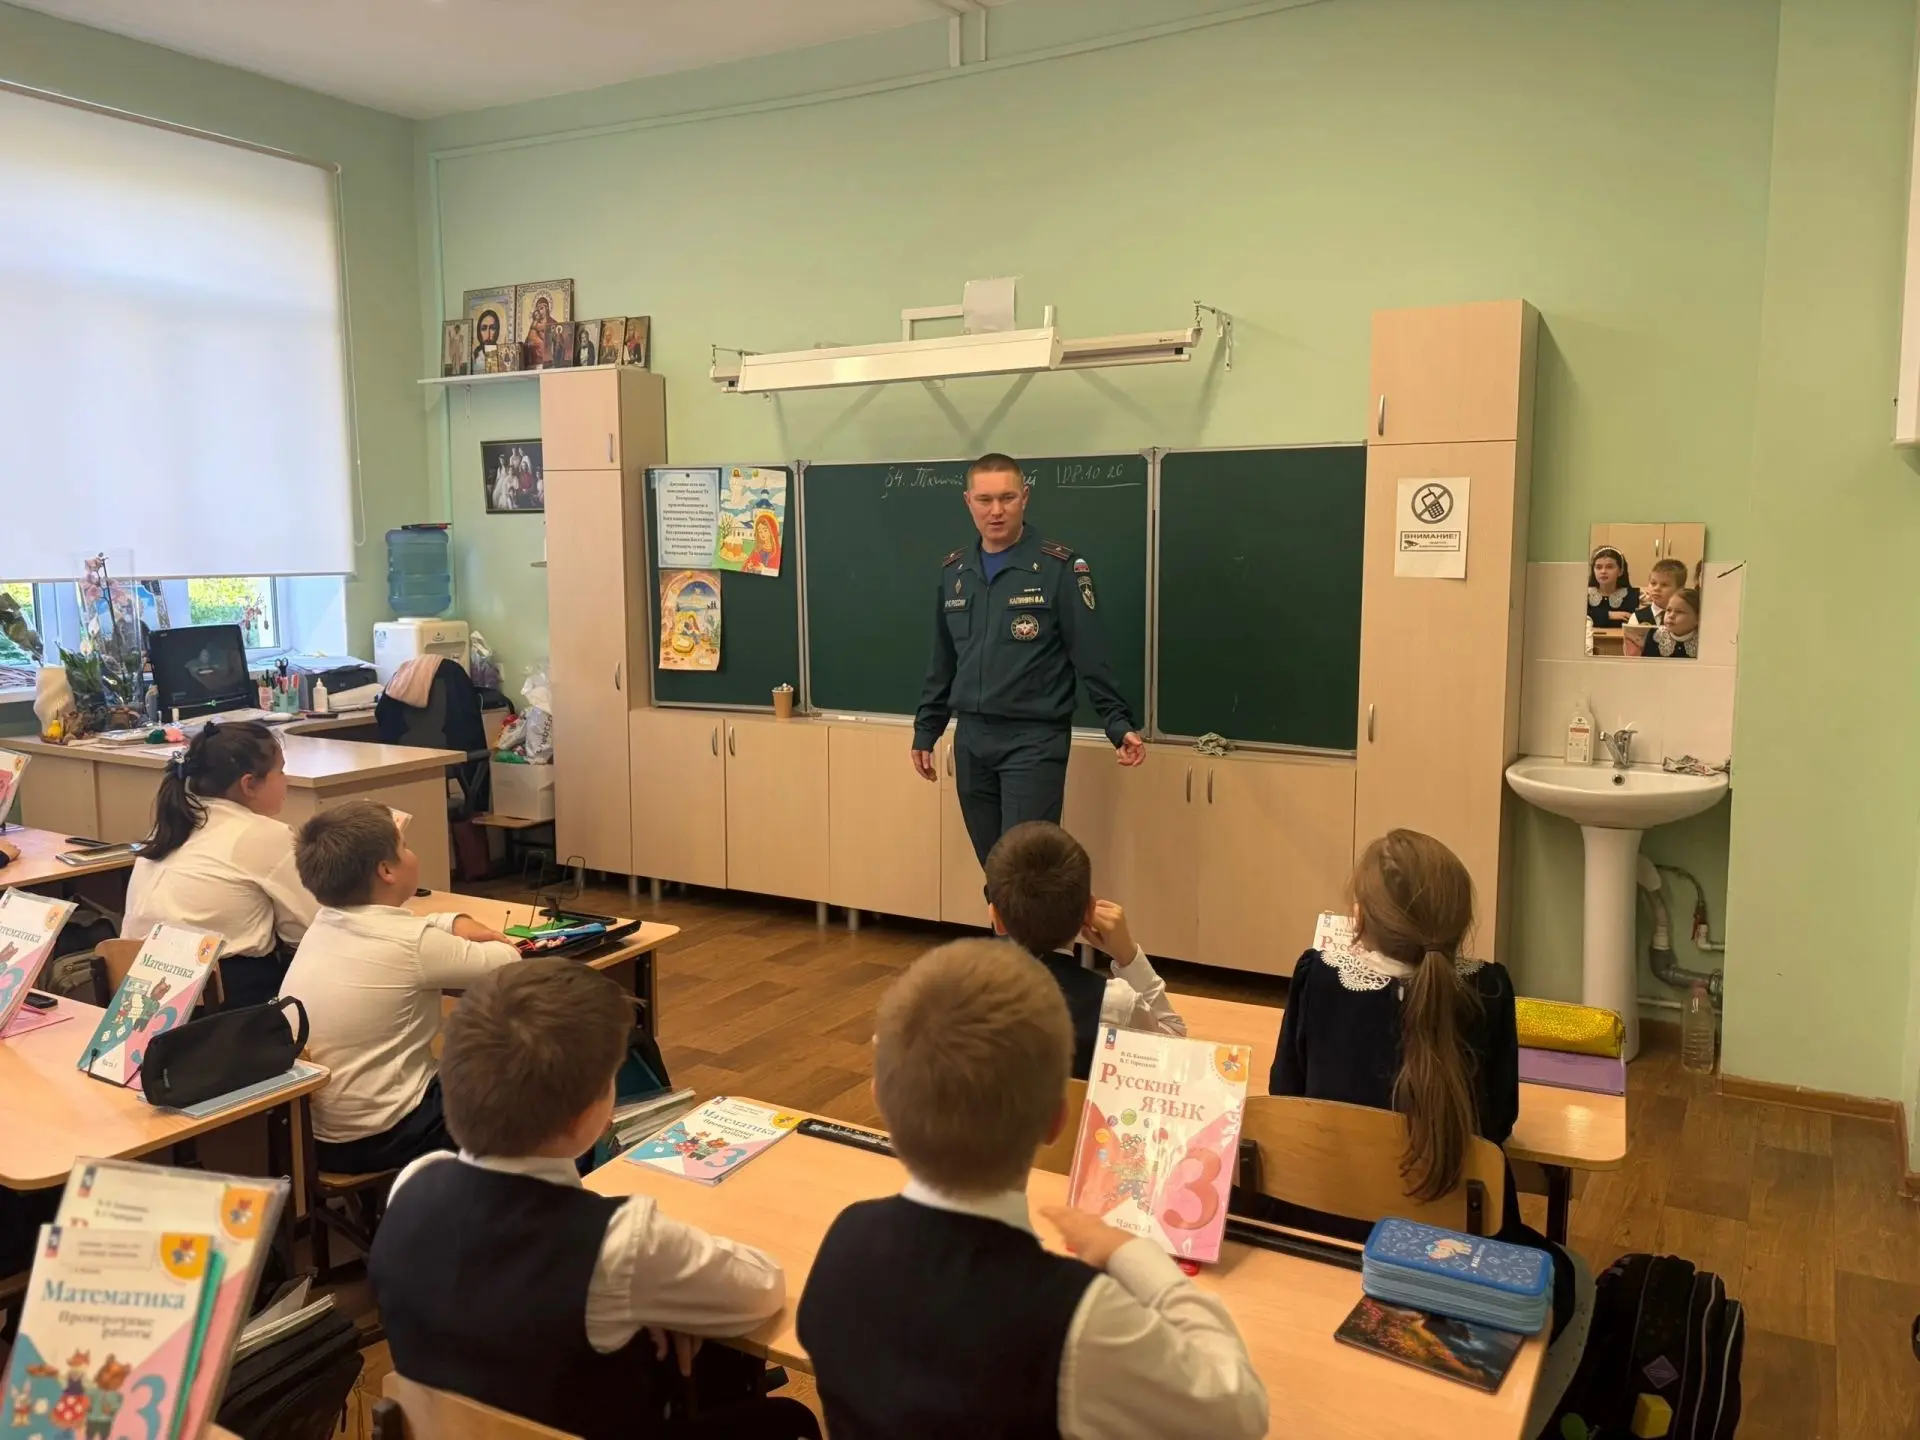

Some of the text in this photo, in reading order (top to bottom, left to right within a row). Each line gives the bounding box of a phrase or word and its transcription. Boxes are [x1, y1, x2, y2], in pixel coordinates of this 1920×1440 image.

[140, 953, 194, 978] Математика
[1099, 1062, 1181, 1096] Русский
[701, 1109, 776, 1135] Математика
[1163, 1147, 1222, 1230] 3
[41, 1280, 186, 1310] Математика
[58, 1310, 155, 1328] Проверочные
[101, 1326, 153, 1340] работы
[118, 1374, 168, 1440] 3
